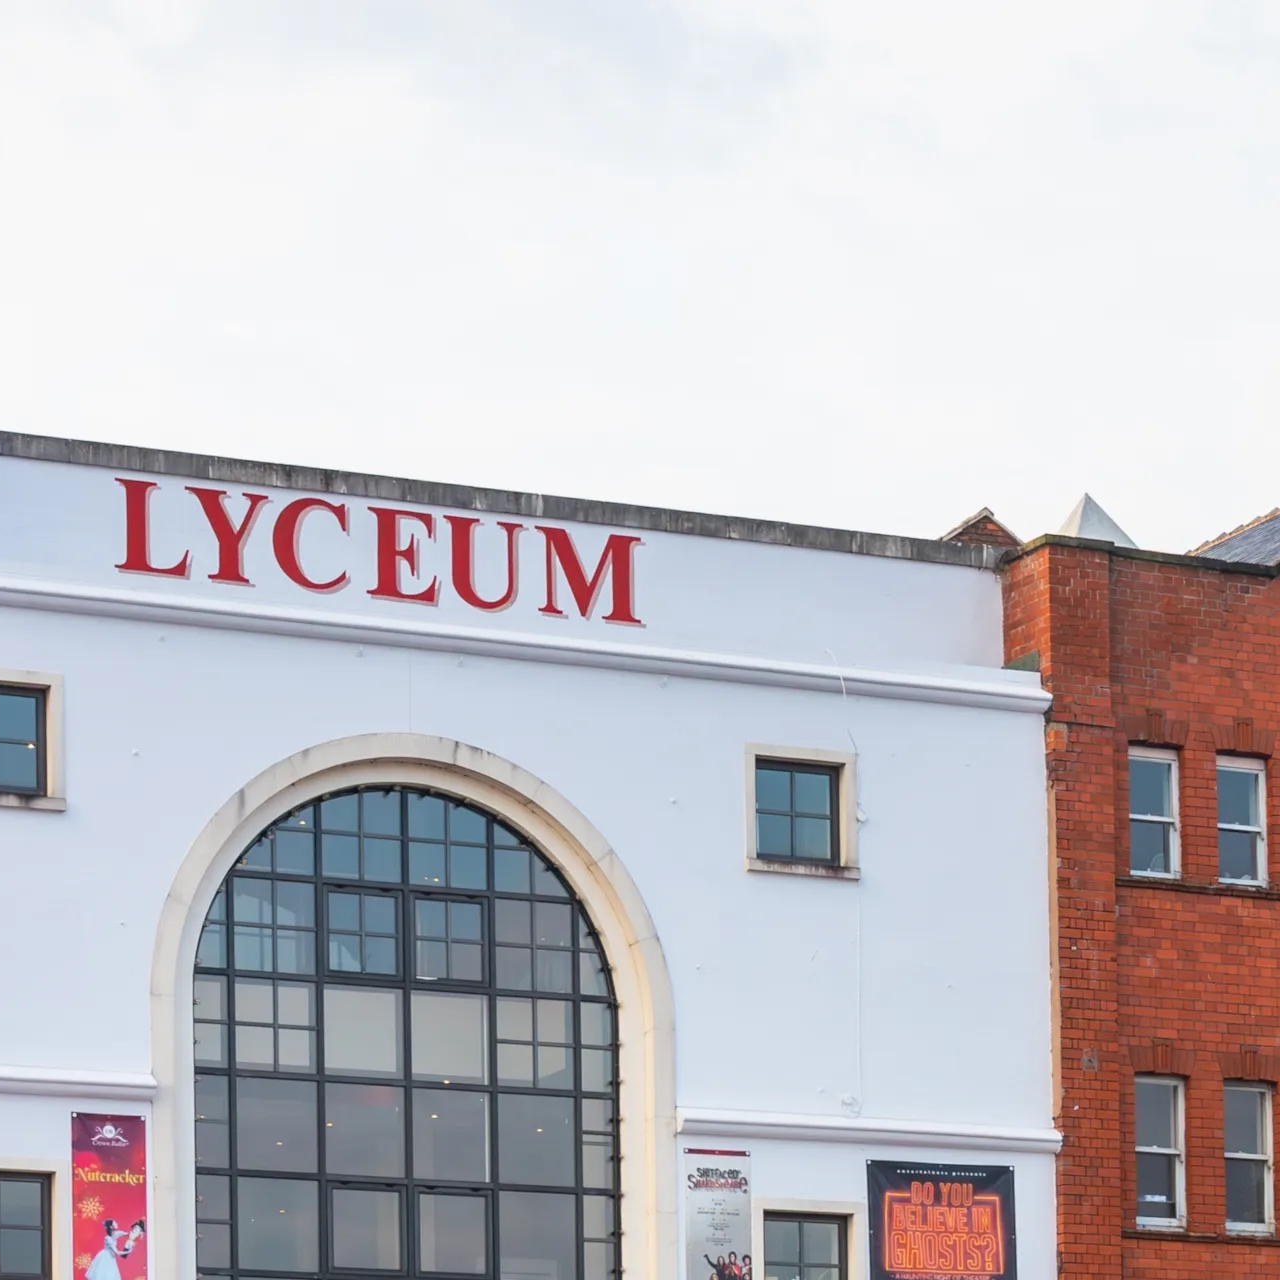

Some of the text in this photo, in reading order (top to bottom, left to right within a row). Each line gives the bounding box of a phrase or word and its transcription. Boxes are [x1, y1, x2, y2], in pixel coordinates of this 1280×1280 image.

[114, 477, 646, 628] LYCEUM
[74, 1167, 146, 1187] Nutcracker
[911, 1181, 973, 1206] DO YOU
[893, 1204, 991, 1233] BELIEVE IN
[891, 1231, 997, 1271] GHOSTS?
